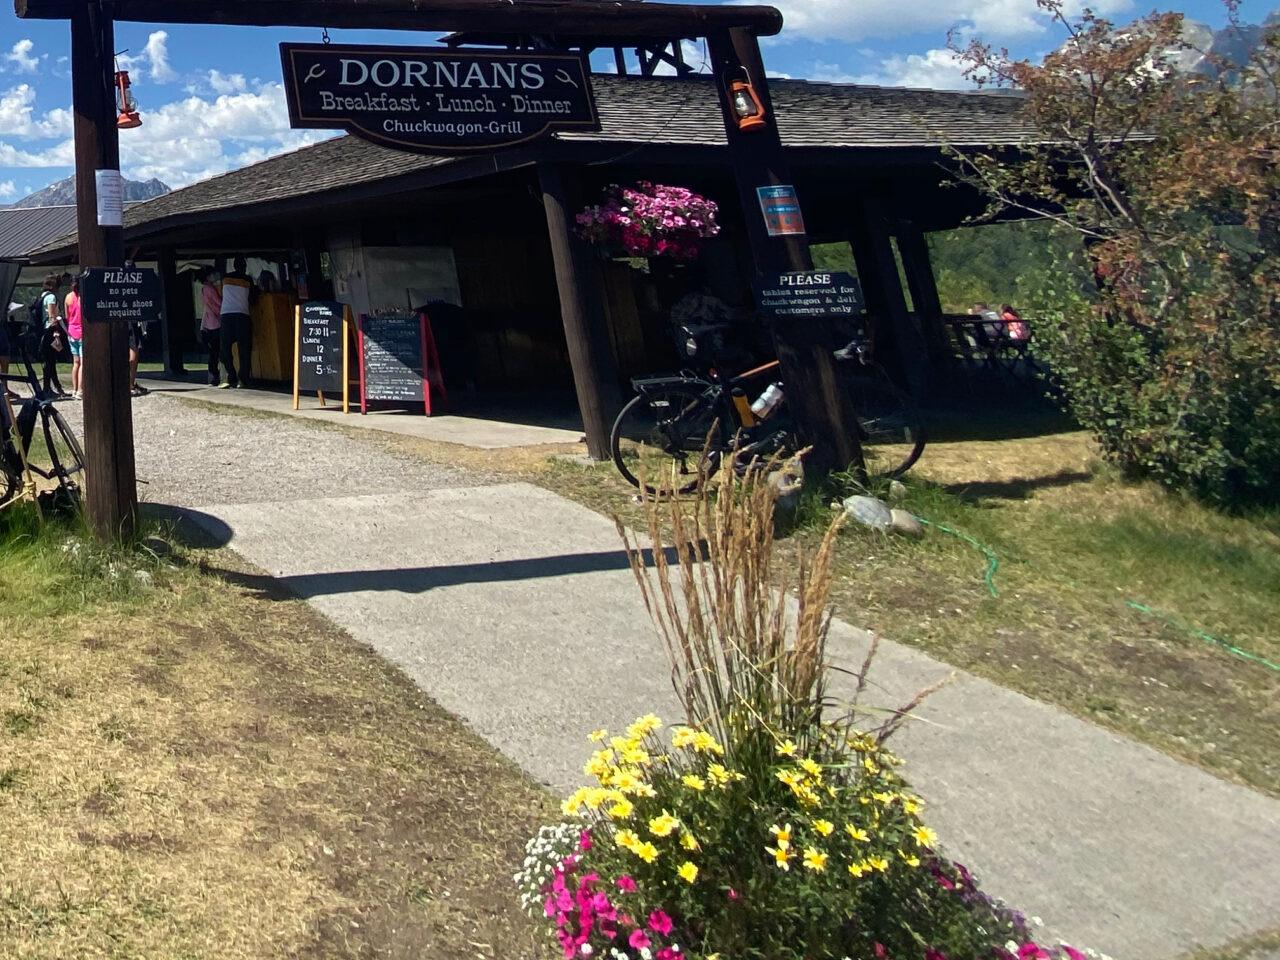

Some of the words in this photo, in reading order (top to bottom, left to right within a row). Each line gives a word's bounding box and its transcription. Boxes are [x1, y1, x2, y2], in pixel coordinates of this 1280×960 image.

[338, 58, 546, 90] DORNANS
[319, 90, 420, 112] Breakfast
[435, 92, 497, 113] Lunch
[510, 94, 572, 115] Dinner
[382, 118, 522, 137] Chuckwagon-Grill
[103, 271, 143, 284] PLEASE
[778, 273, 832, 286] PLEASE
[121, 287, 138, 296] pets
[794, 286, 837, 296] reserved
[840, 285, 855, 294] for
[96, 299, 119, 309] shirts
[121, 300, 128, 308] &
[132, 299, 153, 308] shoes
[761, 296, 821, 306] chuckwagon
[825, 296, 832, 304] &
[836, 295, 857, 304] deli
[109, 307, 142, 318] required
[775, 306, 825, 315] customers
[830, 304, 852, 314] only
[302, 336, 321, 344] LUNCH
[316, 345, 324, 354] 12
[302, 355, 323, 363] DINNER
